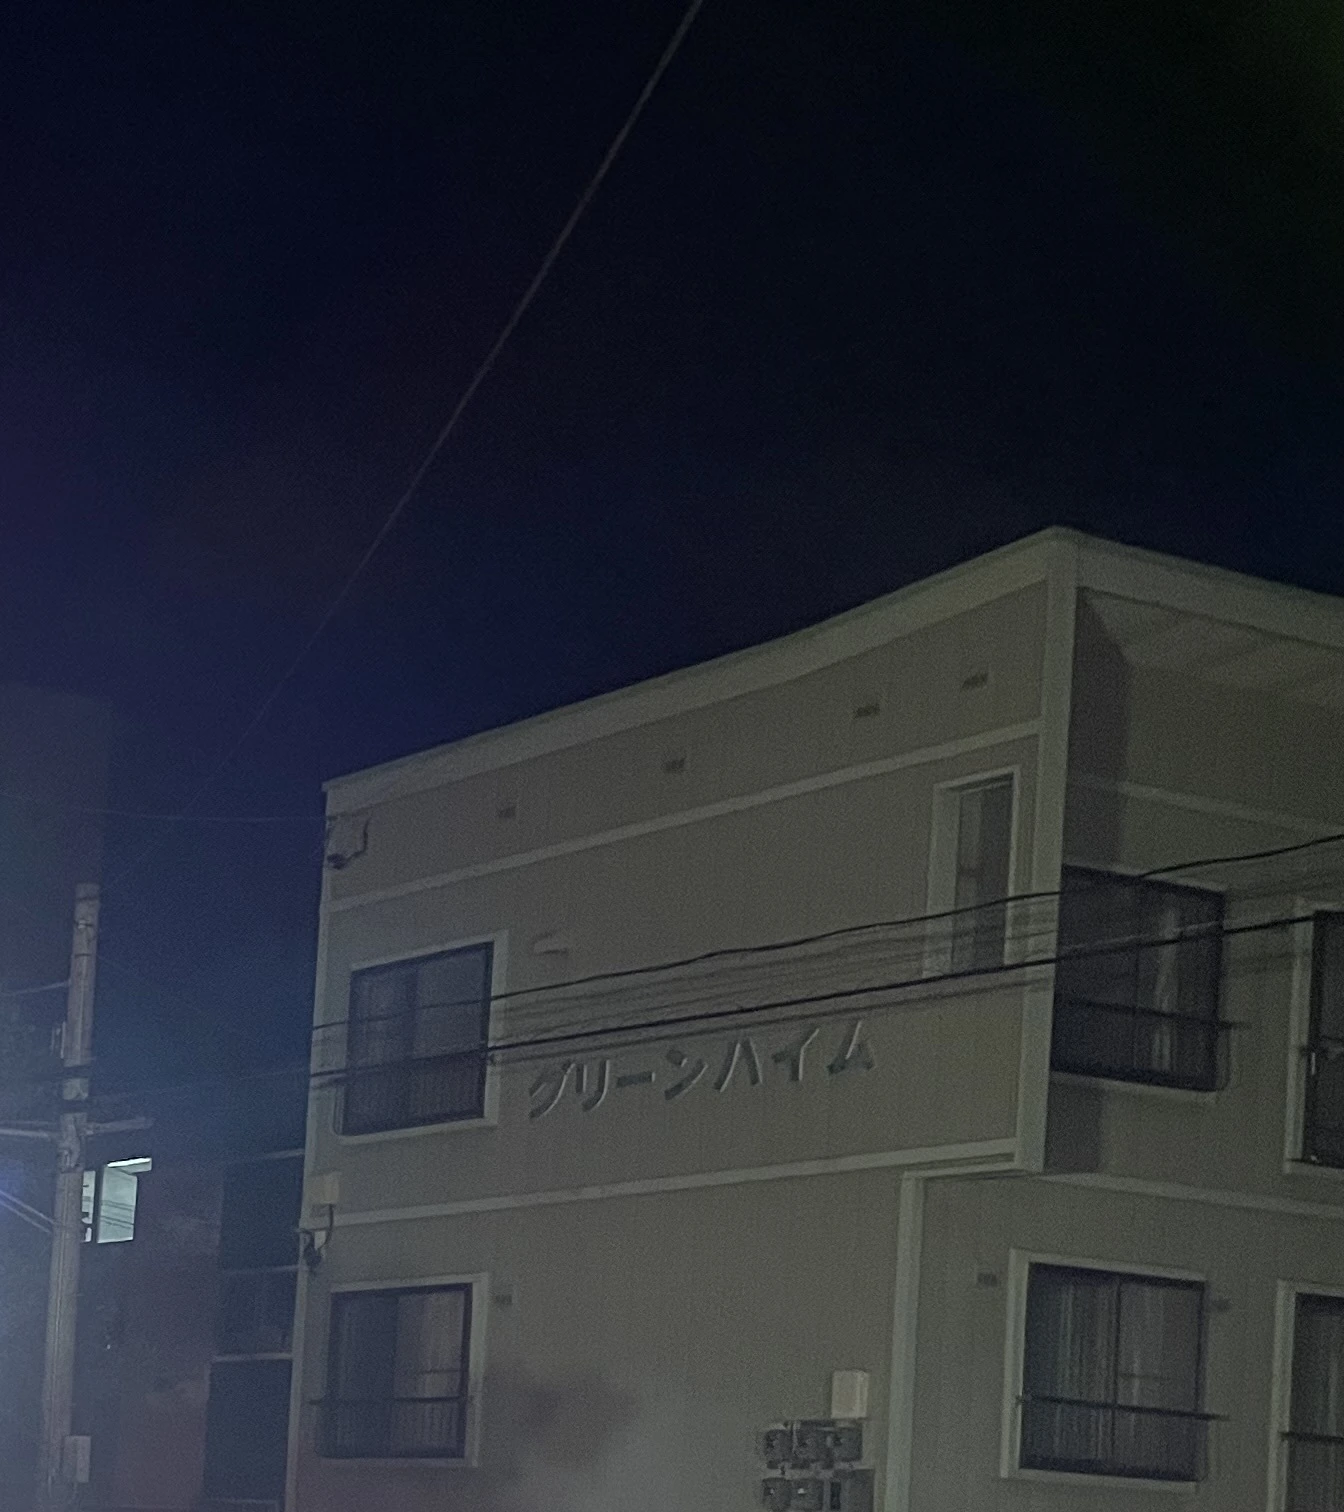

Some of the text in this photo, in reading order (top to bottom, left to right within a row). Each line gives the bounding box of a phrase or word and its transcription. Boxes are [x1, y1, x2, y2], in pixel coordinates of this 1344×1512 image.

[529, 1020, 876, 1119] グリーンハイム
